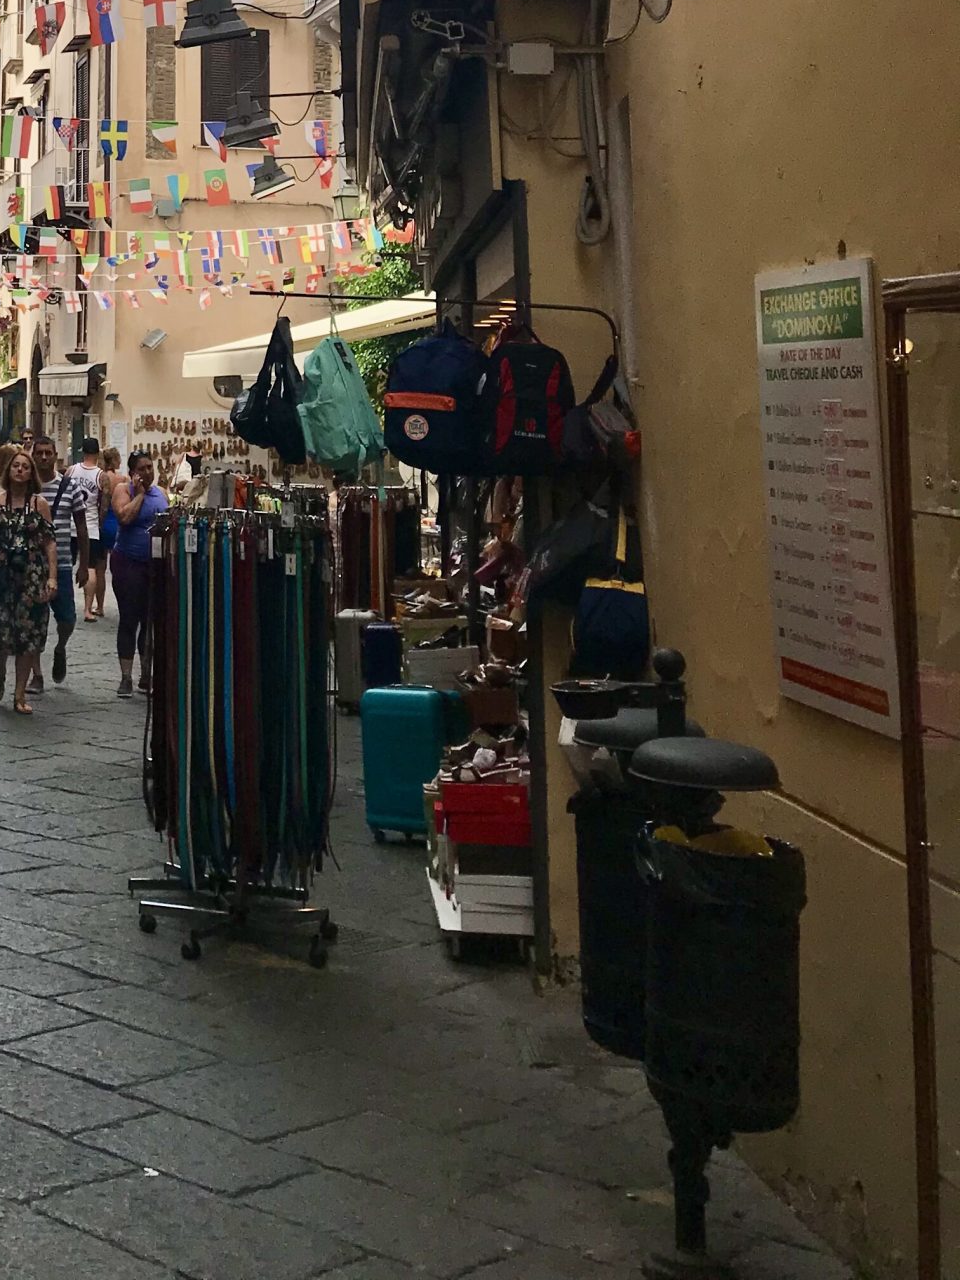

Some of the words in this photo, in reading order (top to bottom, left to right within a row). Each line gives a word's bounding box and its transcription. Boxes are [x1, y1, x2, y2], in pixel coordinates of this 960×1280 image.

[764, 291, 816, 315] EXCHANGE
[819, 286, 858, 309] OFFICE
[780, 347, 797, 362] RATE
[798, 348, 808, 362] OF
[810, 348, 824, 361] THE
[825, 346, 842, 360] DAY
[766, 368, 789, 381] TRAVEL
[790, 367, 819, 381] CHEQUE
[821, 366, 838, 380] AND
[840, 365, 863, 379] CASH
